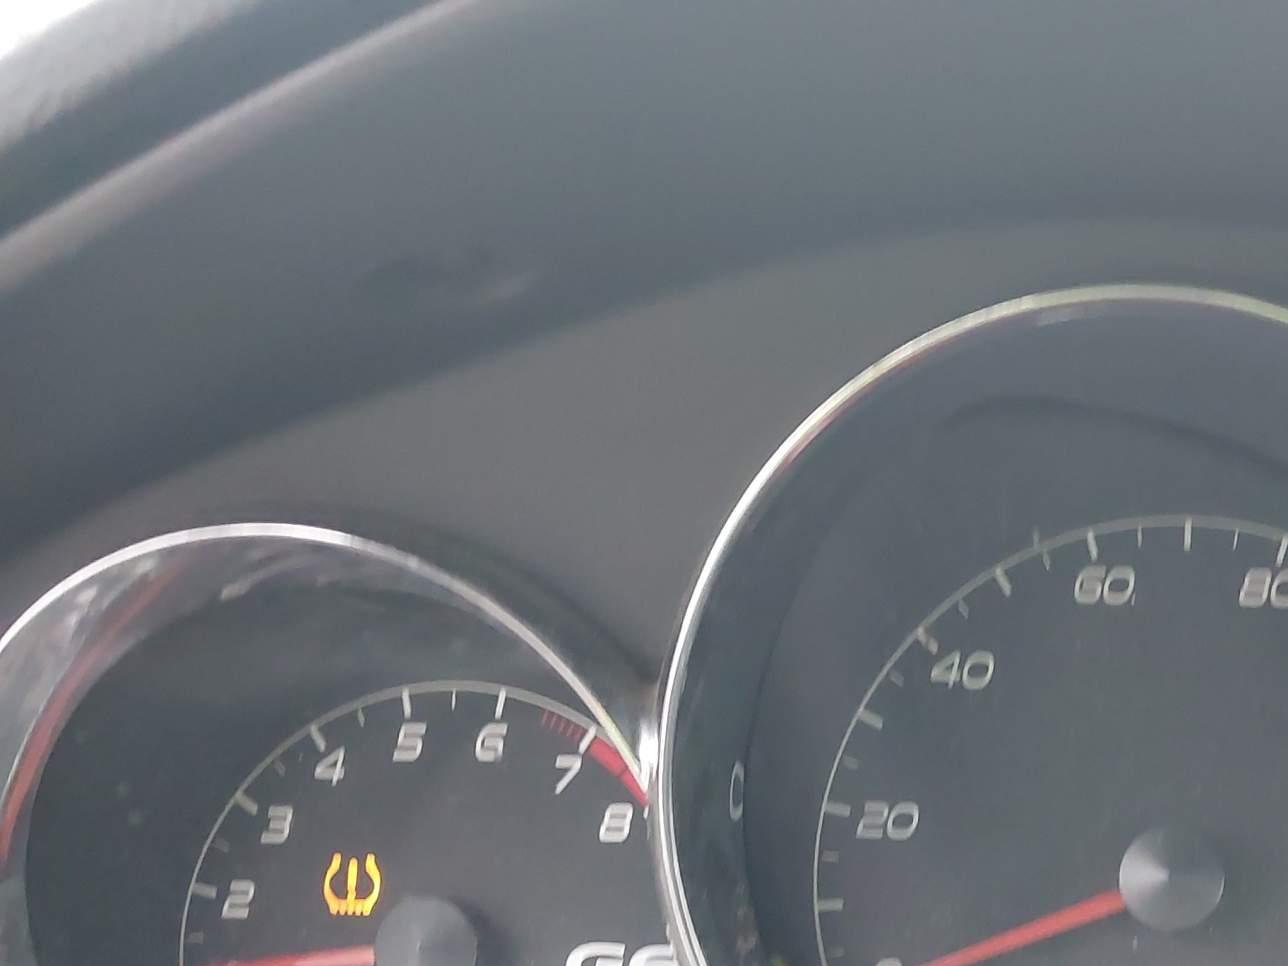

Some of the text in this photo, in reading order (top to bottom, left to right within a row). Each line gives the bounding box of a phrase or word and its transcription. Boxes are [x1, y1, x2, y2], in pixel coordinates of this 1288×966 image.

[1074, 565, 1135, 605] 60
[930, 650, 994, 690] 40
[394, 723, 426, 763] 5
[475, 723, 507, 762] 6
[314, 747, 346, 786] 4
[555, 754, 583, 794] 7
[261, 806, 293, 844] 3
[599, 802, 633, 843] 8
[856, 801, 919, 841] 20
[222, 879, 254, 919] 2
